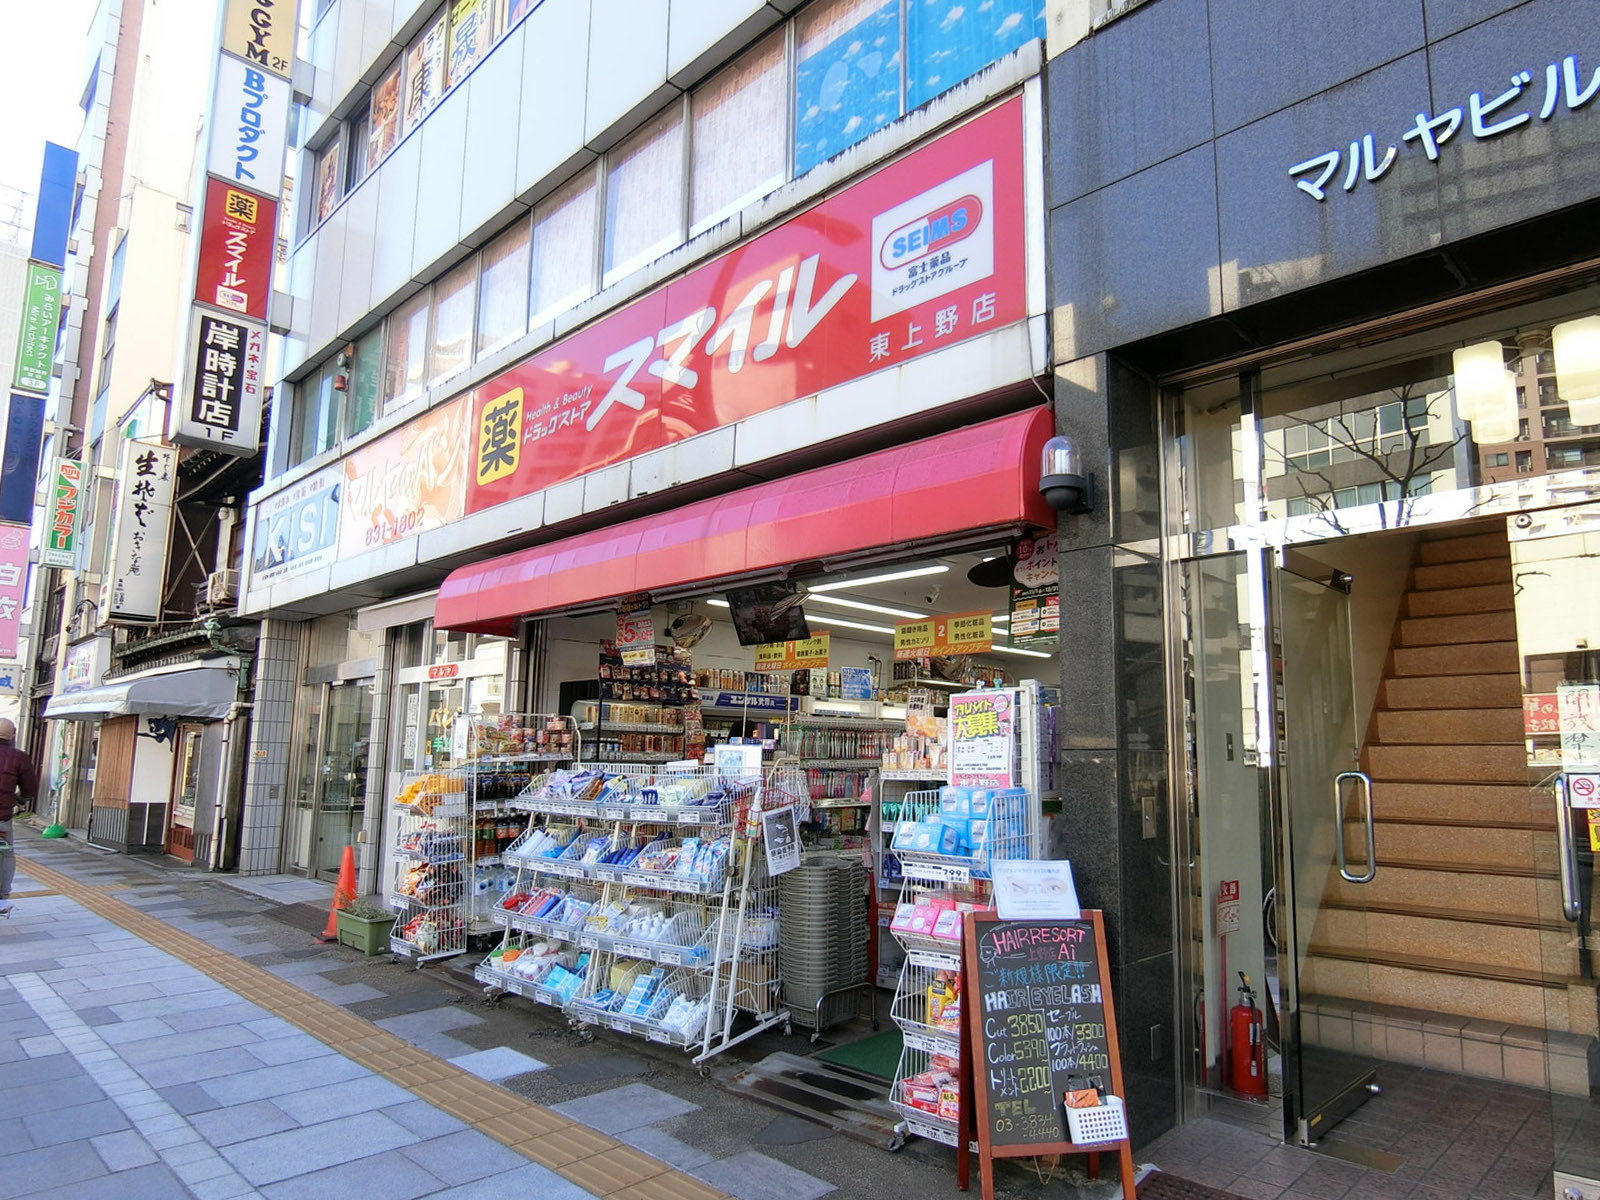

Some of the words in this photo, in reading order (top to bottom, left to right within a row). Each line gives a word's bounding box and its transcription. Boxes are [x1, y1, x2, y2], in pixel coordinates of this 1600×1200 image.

[272, 56, 289, 72] 2F
[235, 67, 269, 180] Bプロダクト
[1288, 53, 1600, 201] マルヤビル
[228, 193, 256, 222] 薬
[891, 207, 968, 260] SEIMS
[222, 230, 248, 288] スマイル
[908, 251, 952, 279] 富士薬品
[891, 257, 969, 297] ドラッグストアグループ
[585, 252, 858, 432] スマイル
[868, 291, 997, 364] 東上野店
[198, 321, 240, 427] 岸時計店
[526, 401, 551, 421] Health
[562, 385, 593, 406] Beauty
[205, 426, 234, 441] 1F
[523, 400, 593, 446] ドラッグストア
[480, 399, 520, 477] 薬
[53, 485, 79, 549] フジカラー
[365, 506, 425, 546] 831-1802
[938, 624, 945, 637] 2
[788, 643, 793, 653] 1
[953, 711, 999, 739] 大募集
[942, 869, 962, 877] 799
[992, 928, 1031, 955] HAIR
[1028, 927, 1086, 945] RESORT
[1057, 943, 1076, 960] Ai
[984, 987, 1028, 1011] HAIR
[1030, 983, 1102, 1007] EYELASH
[985, 1017, 1009, 1039] Cut
[1007, 1013, 1044, 1038] 3850
[988, 1042, 1017, 1064] Color
[994, 1099, 1037, 1116] TEL
